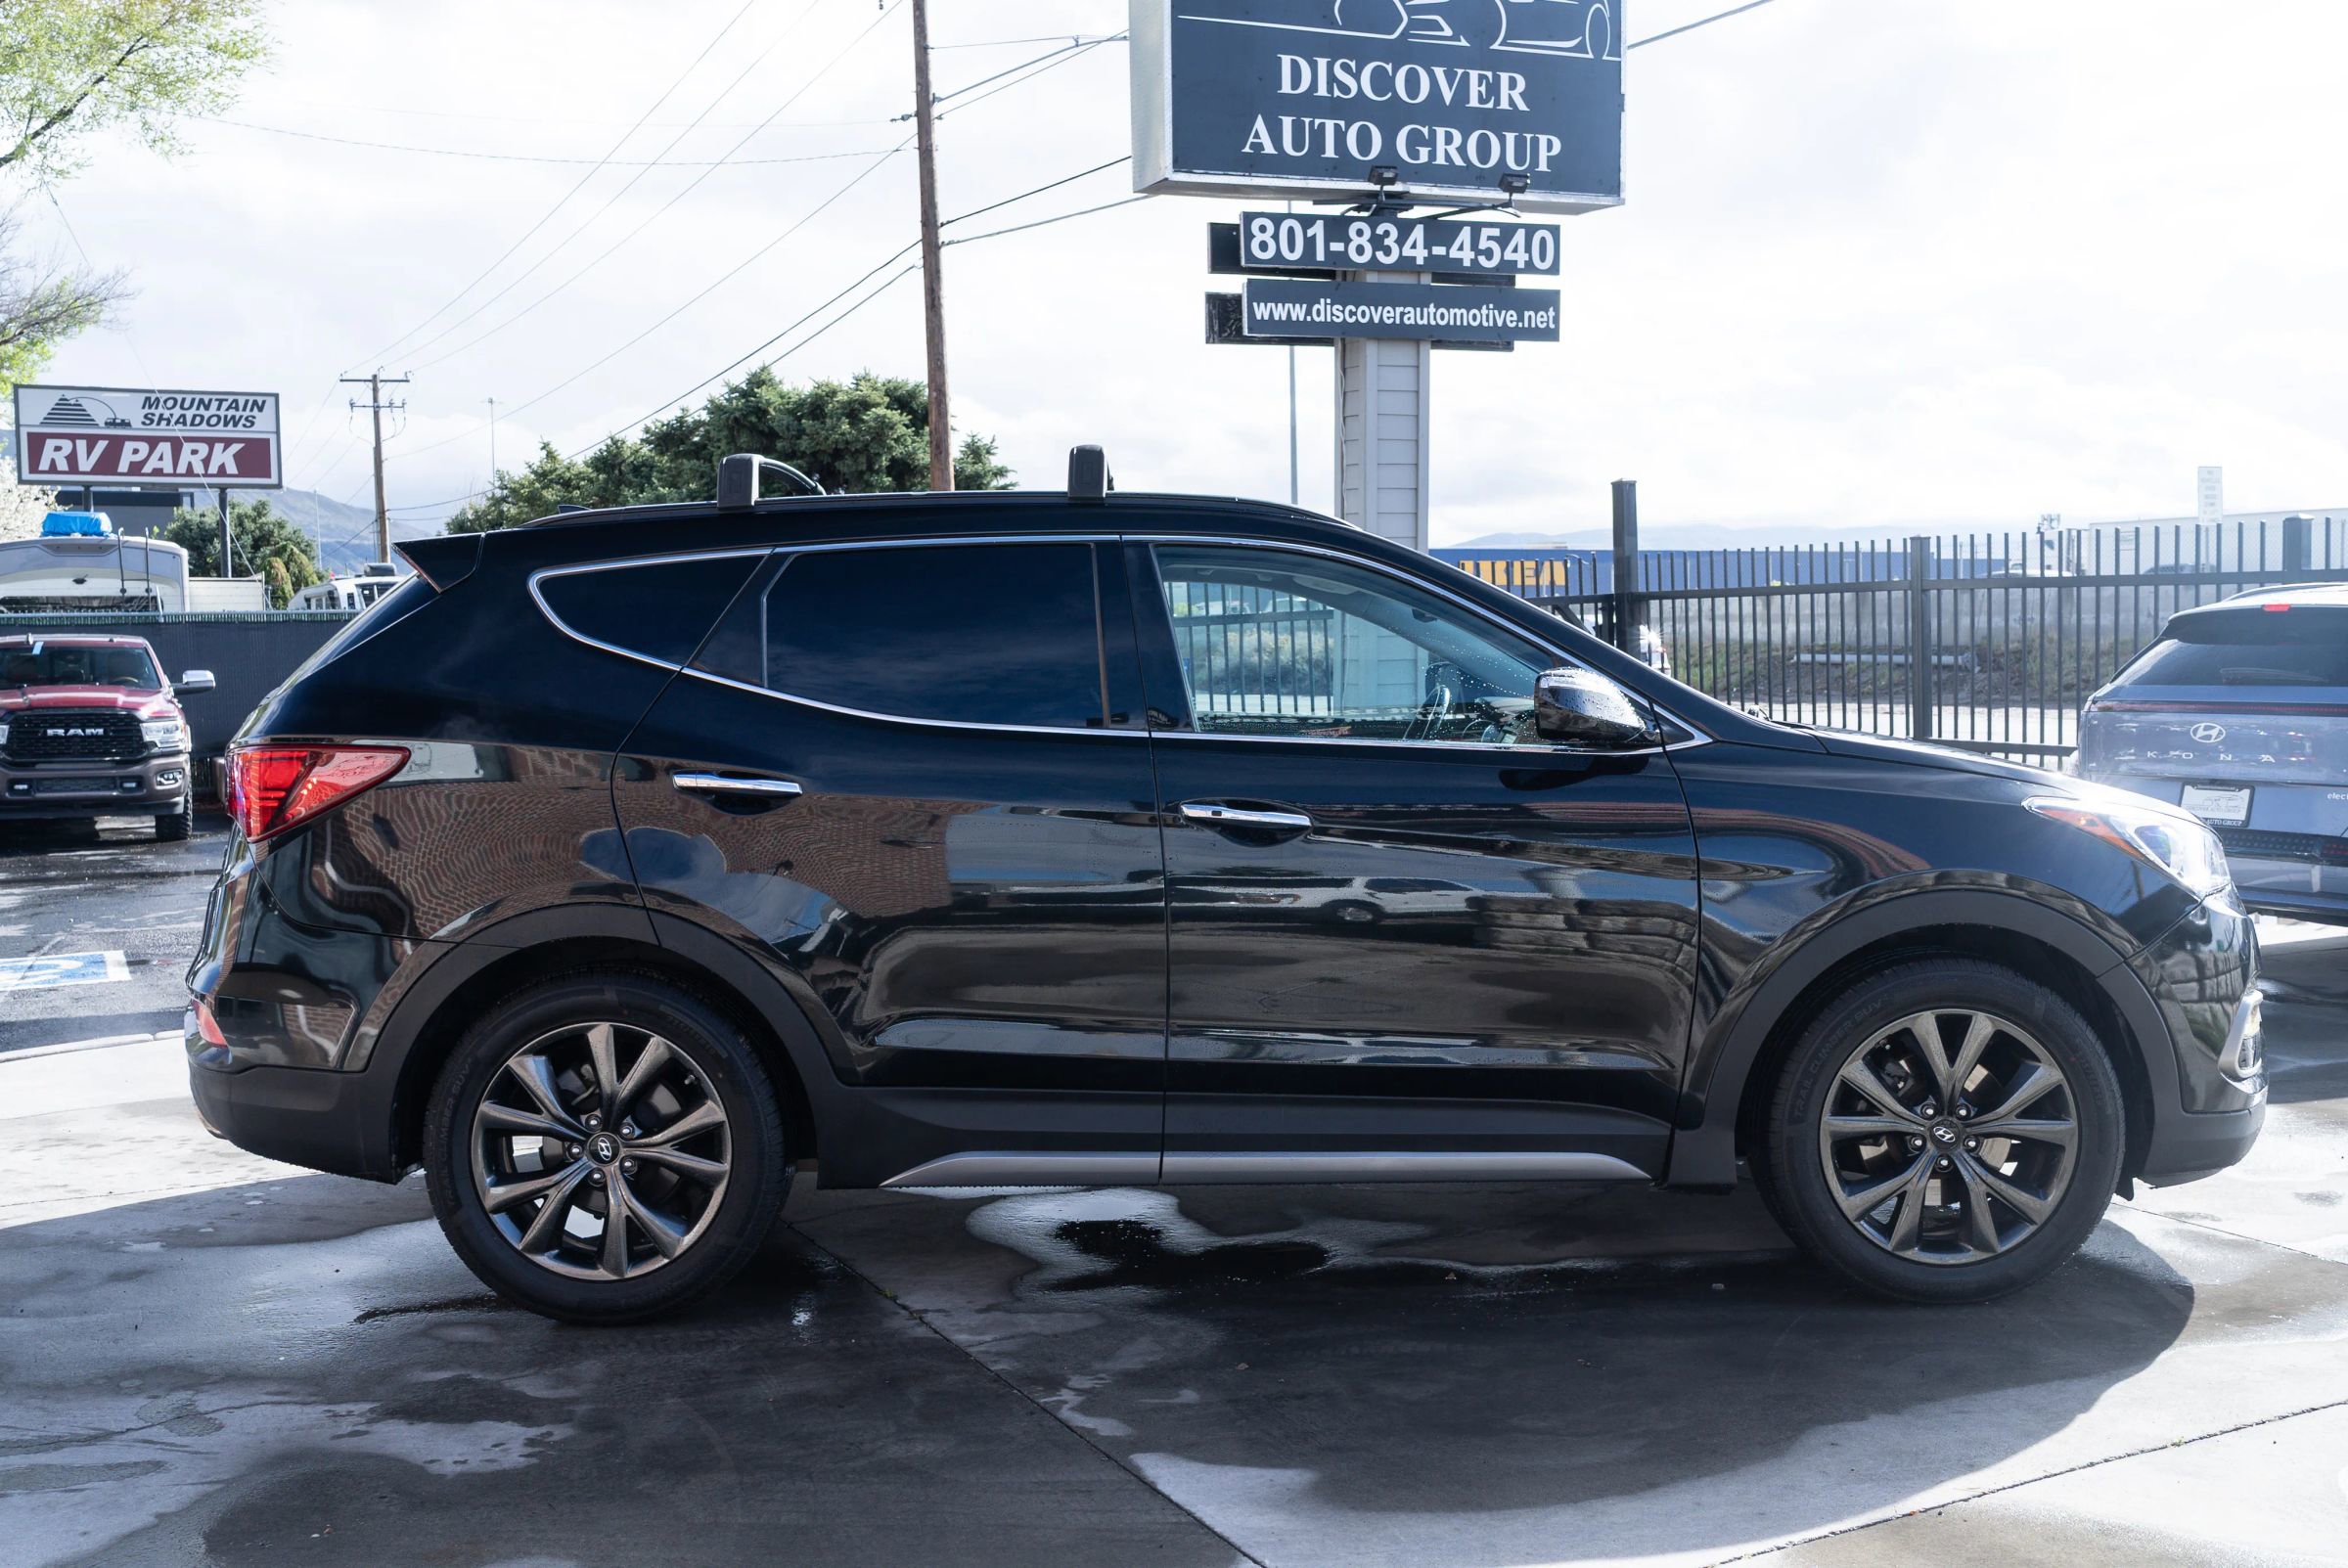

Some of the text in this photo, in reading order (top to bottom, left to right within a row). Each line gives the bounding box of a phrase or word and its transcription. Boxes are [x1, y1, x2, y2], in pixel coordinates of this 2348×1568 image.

[1277, 54, 1530, 112] DISCOVER
[1242, 112, 1562, 173] AUTO GROUP
[1249, 217, 1556, 271] 801-834-4540
[1252, 297, 1556, 331] www.discoverautomotive.net
[140, 413, 256, 428] SHADOWS
[141, 396, 266, 413] MOUNTAIN
[38, 438, 246, 475] RV PARK
[46, 728, 105, 737] RAM
[2146, 750, 2276, 763] KONA
